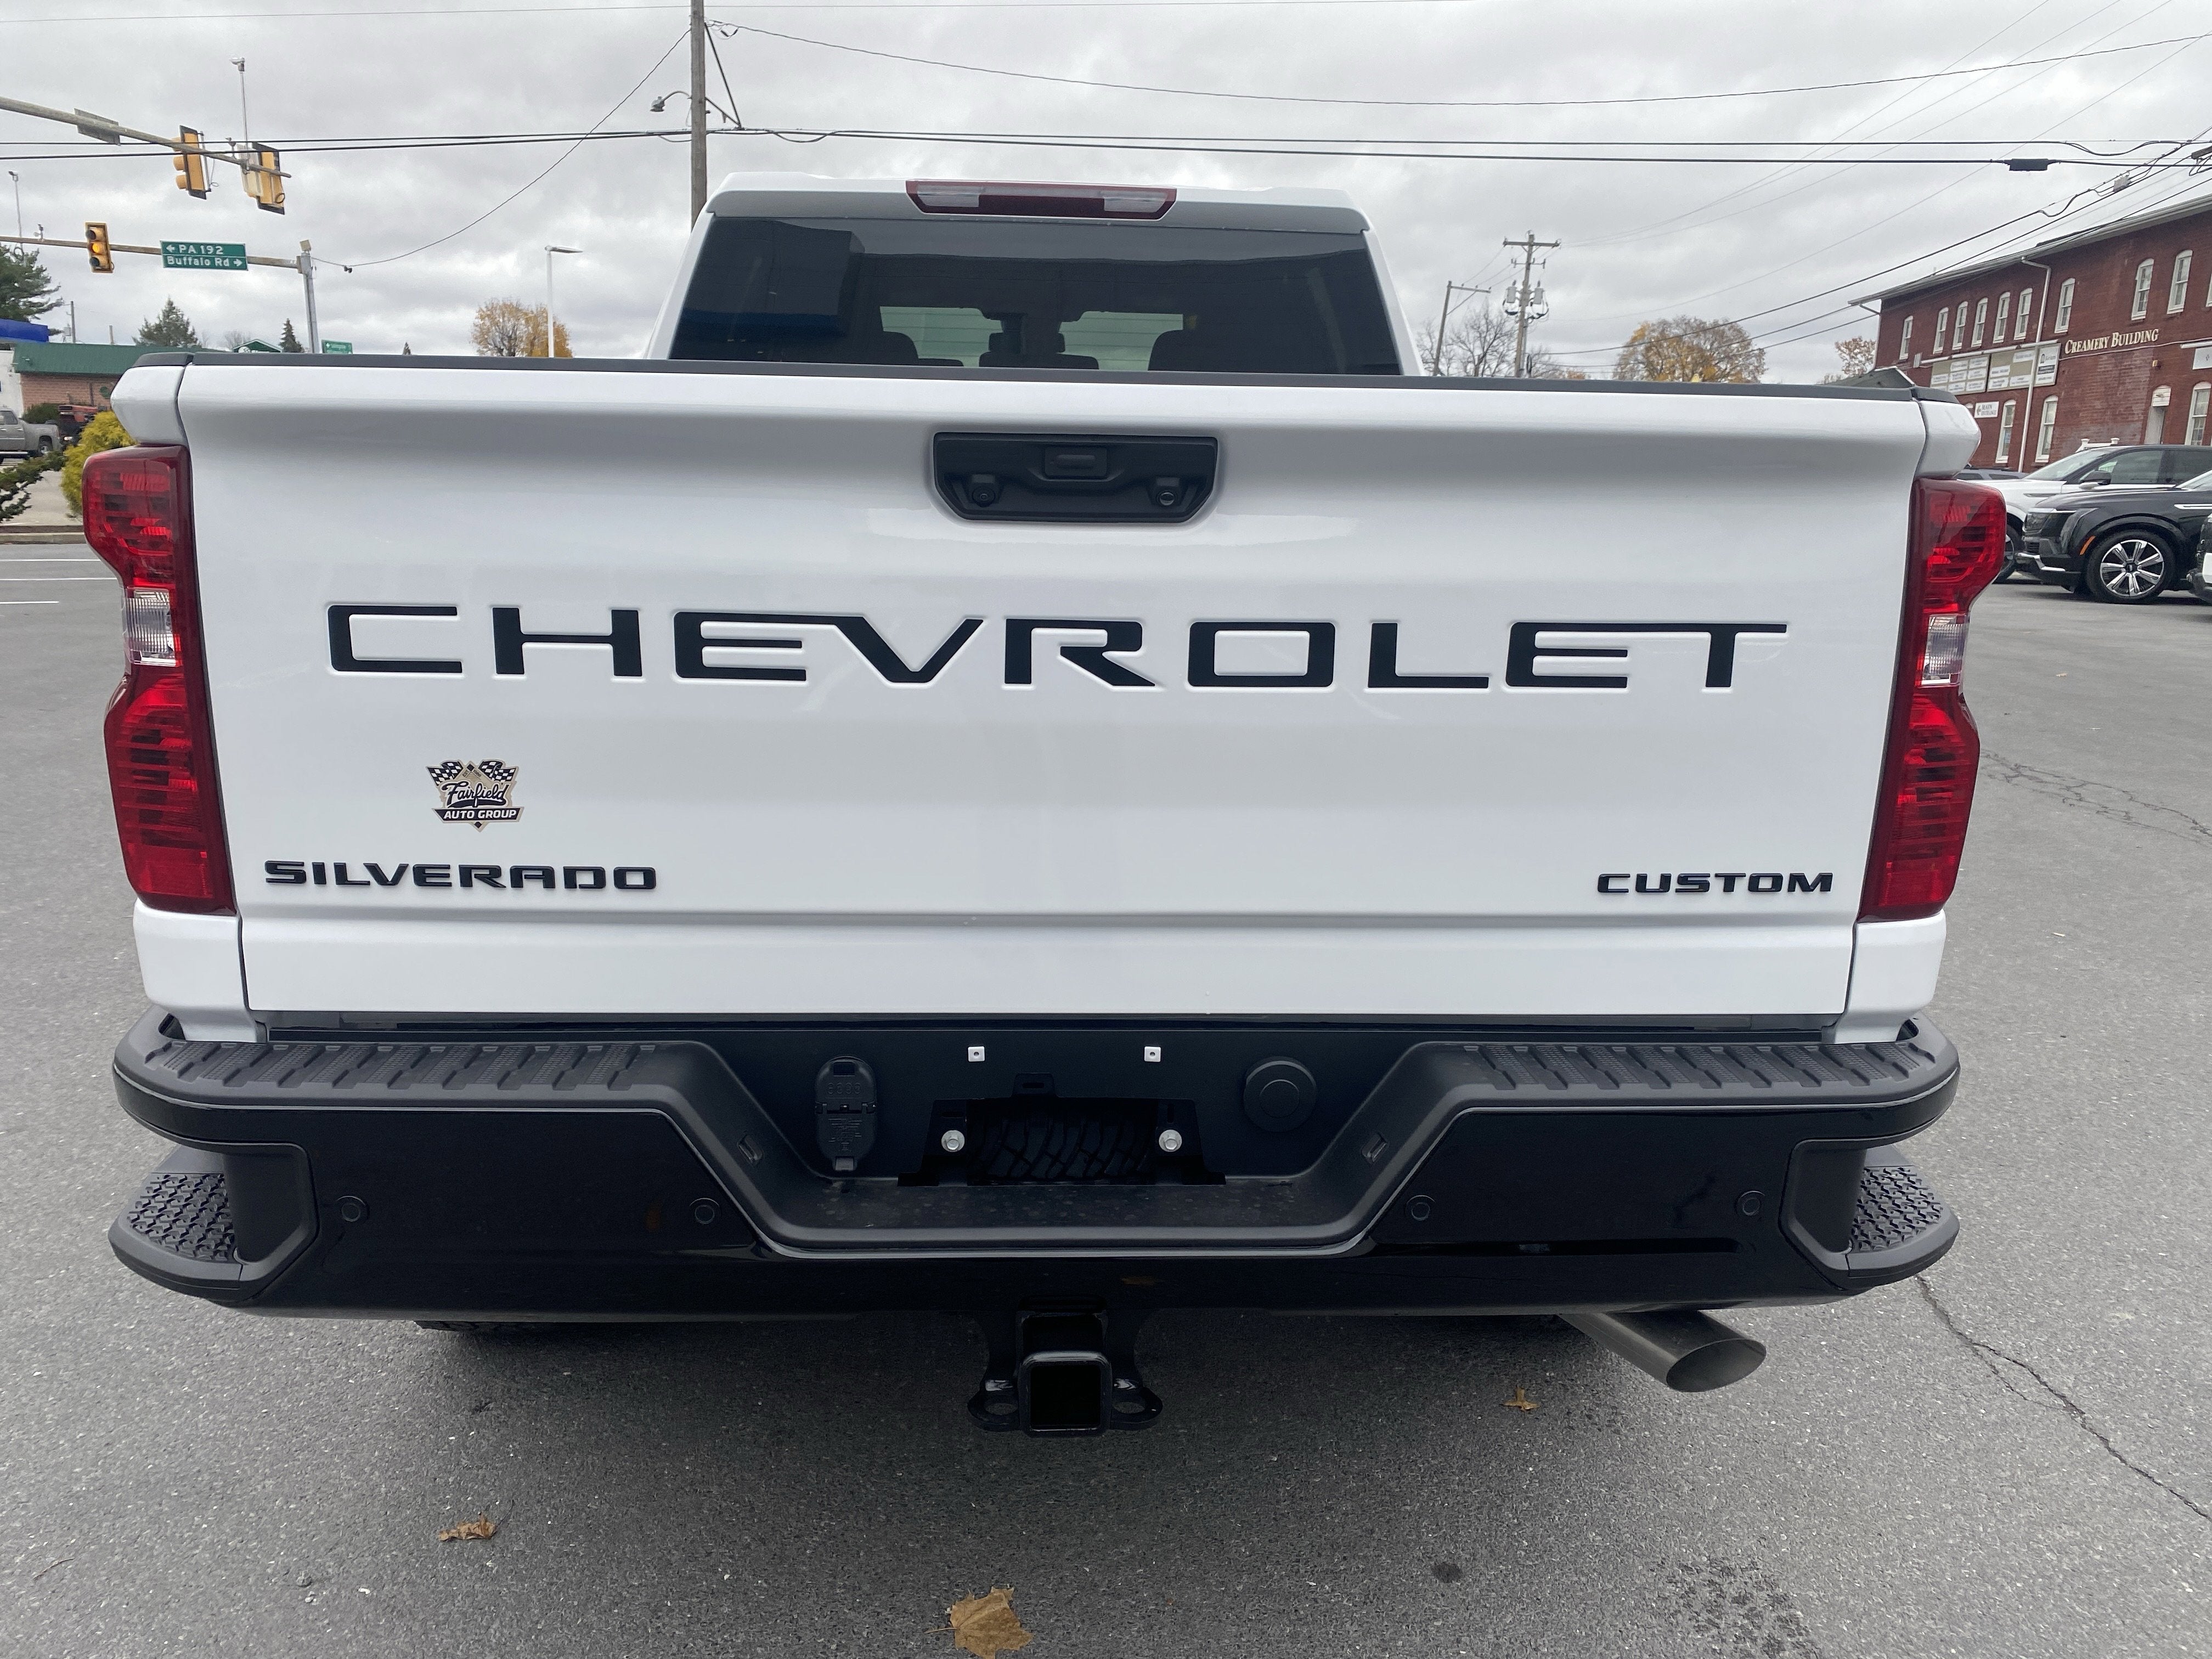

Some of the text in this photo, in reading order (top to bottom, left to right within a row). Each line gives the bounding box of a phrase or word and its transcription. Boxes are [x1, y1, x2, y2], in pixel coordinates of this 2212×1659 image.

[179, 244, 223, 255] PA 192
[167, 256, 229, 267] Buffalo Rd
[2064, 329, 2159, 354] CREAMERY BUILDING
[328, 605, 1787, 689] CHEVROLET
[441, 781, 509, 807] Fairfield
[443, 810, 517, 819] AUTO GROUP
[265, 860, 656, 890] SILVERADO
[1598, 873, 1833, 893] CUSTOM
